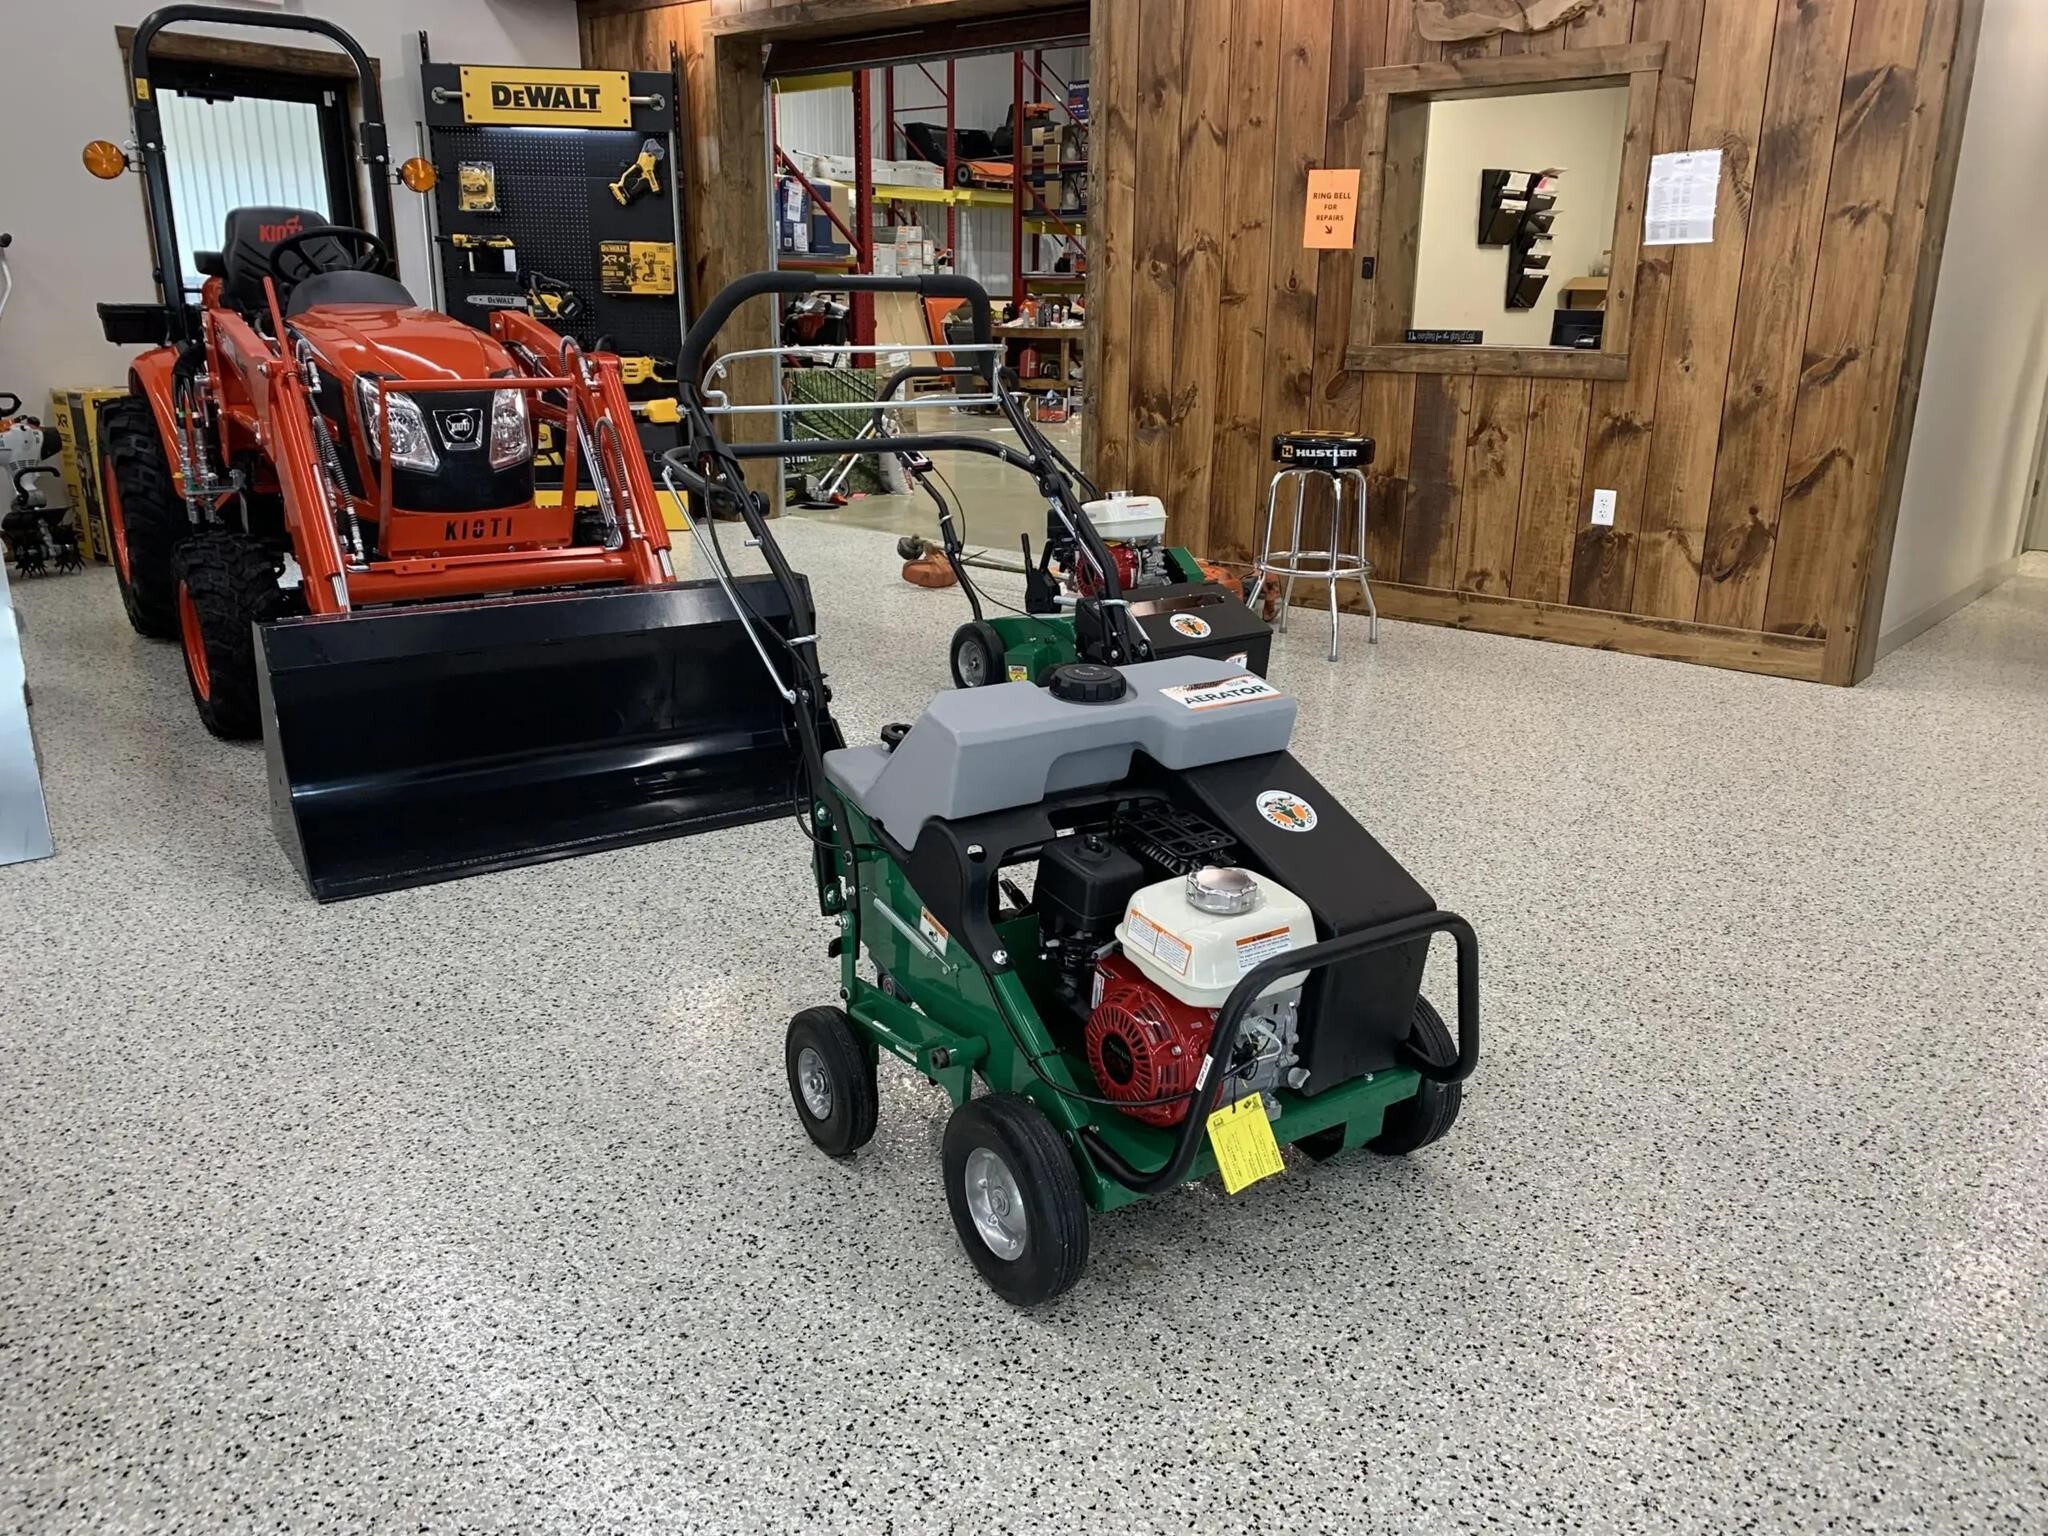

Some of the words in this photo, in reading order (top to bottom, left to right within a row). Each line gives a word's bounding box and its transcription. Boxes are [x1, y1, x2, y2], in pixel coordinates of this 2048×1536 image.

[491, 85, 601, 109] DEWALT
[1296, 449, 1357, 457] HUSTLER
[445, 517, 512, 541] KIOTI
[1184, 685, 1269, 704] AERATOR
